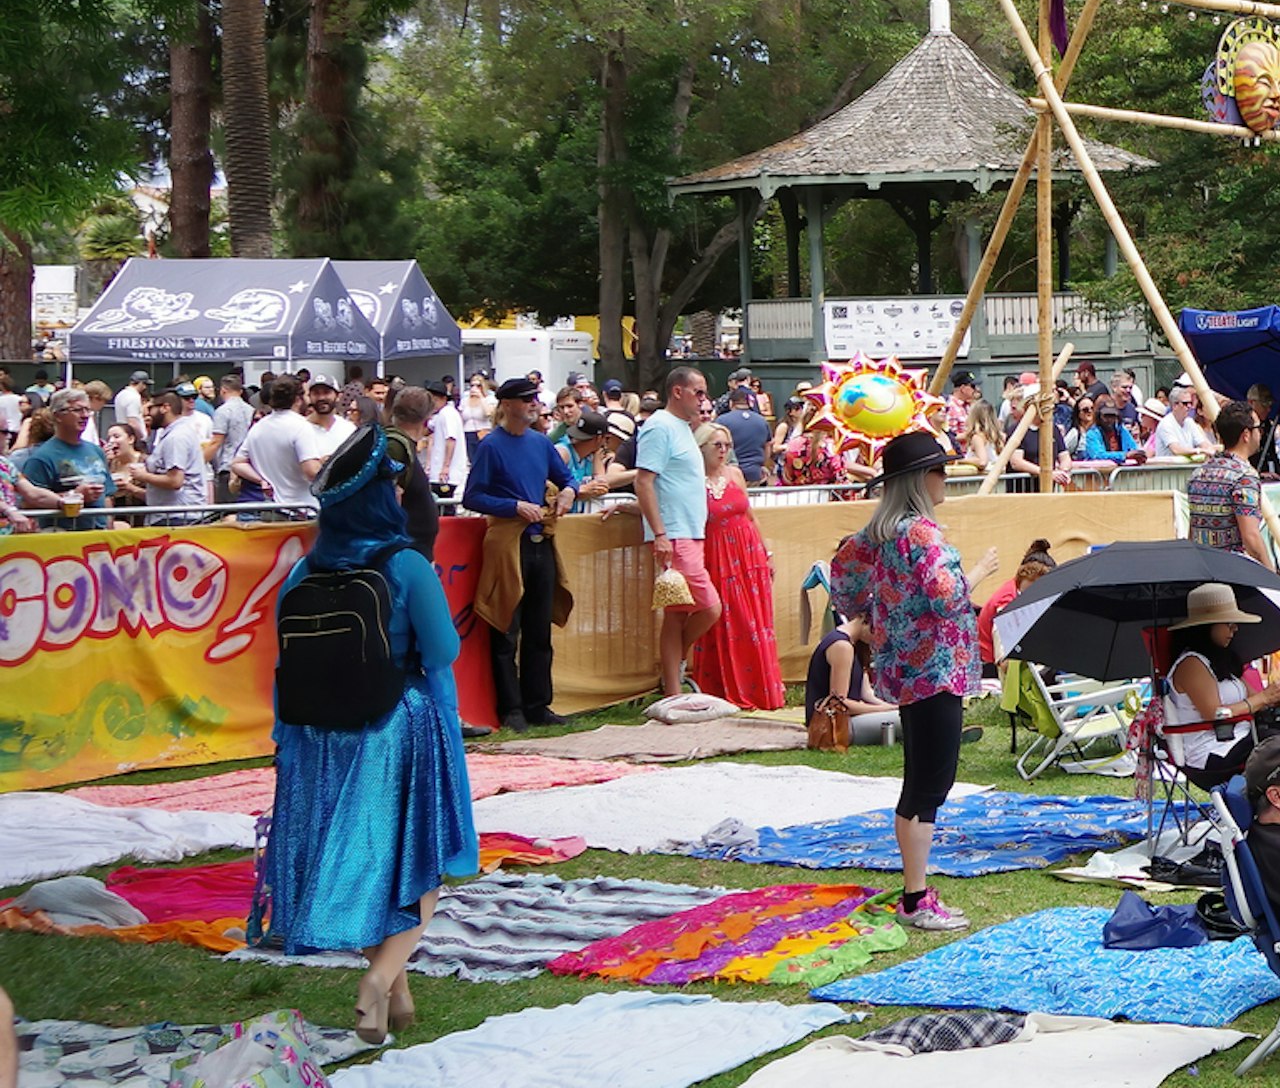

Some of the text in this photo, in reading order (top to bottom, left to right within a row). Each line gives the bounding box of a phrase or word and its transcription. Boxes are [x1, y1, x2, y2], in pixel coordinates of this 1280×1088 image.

[1207, 315, 1259, 329] TECATE LIGHT
[108, 336, 250, 350] FIRESTONE WALKER
